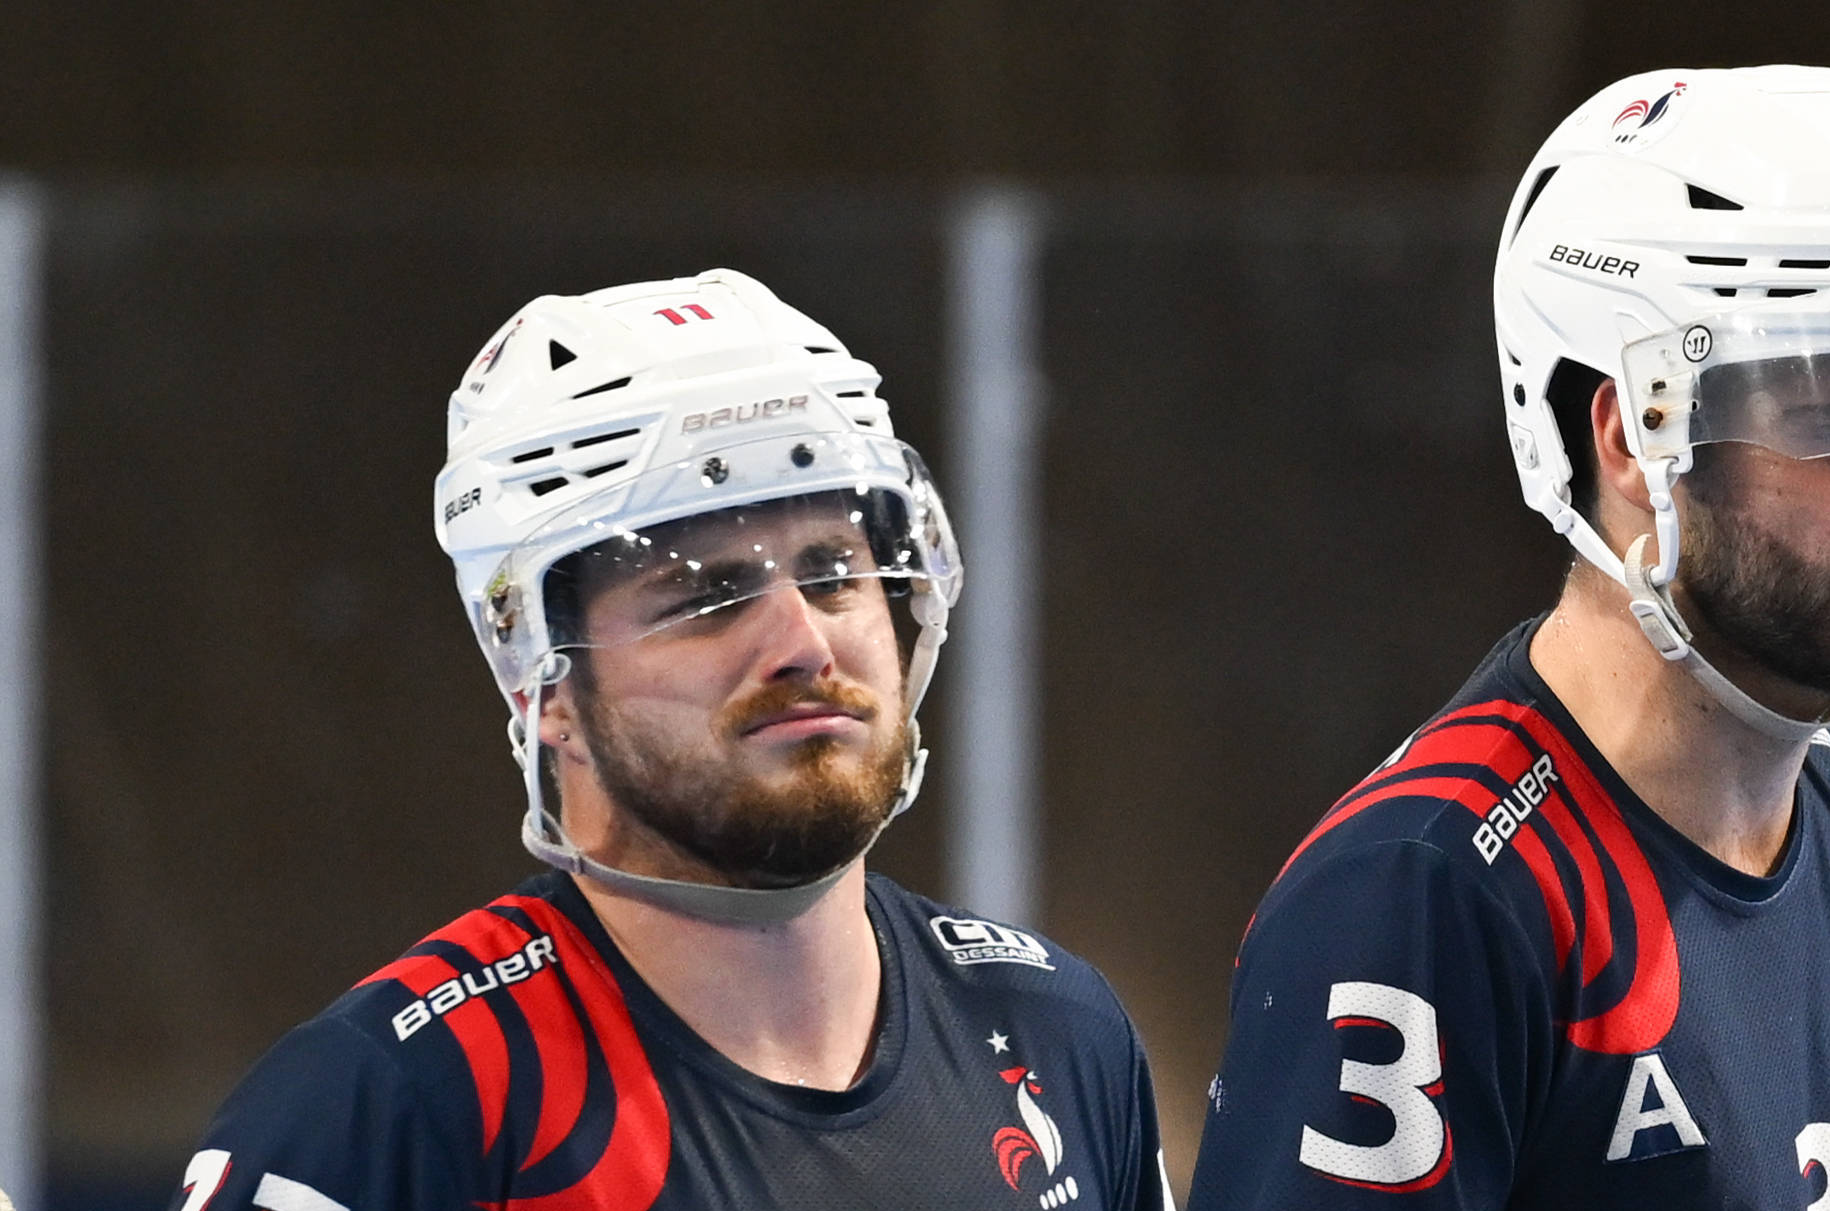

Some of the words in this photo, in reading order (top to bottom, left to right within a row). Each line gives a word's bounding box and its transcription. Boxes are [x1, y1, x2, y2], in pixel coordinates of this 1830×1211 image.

[653, 303, 715, 326] 11
[1299, 981, 1453, 1193] 3
[1606, 1055, 1706, 1161] A
